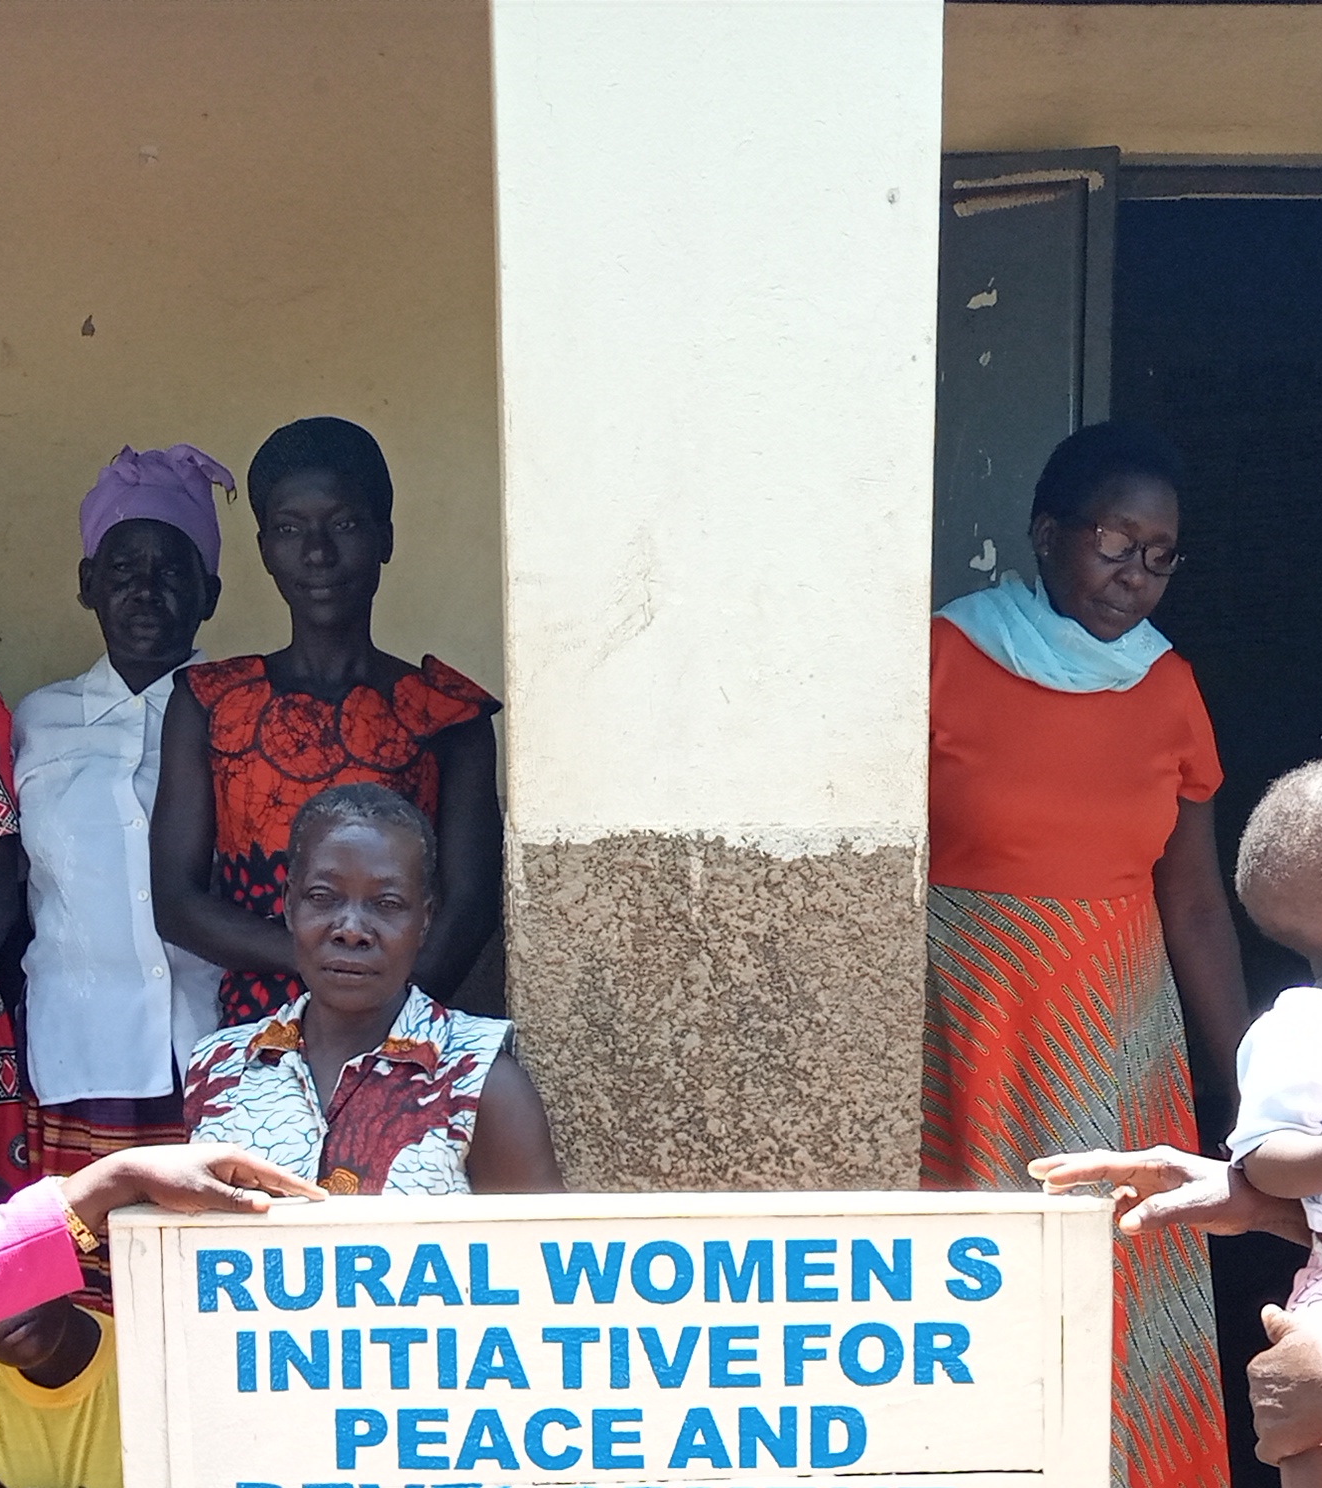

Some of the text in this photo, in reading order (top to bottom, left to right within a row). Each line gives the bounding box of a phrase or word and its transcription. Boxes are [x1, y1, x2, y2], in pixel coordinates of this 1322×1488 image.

[196, 1243, 520, 1313] RURAL
[540, 1238, 913, 1305] WOMEN
[782, 1321, 974, 1387] FOR
[334, 1404, 868, 1471] PEACE AND
